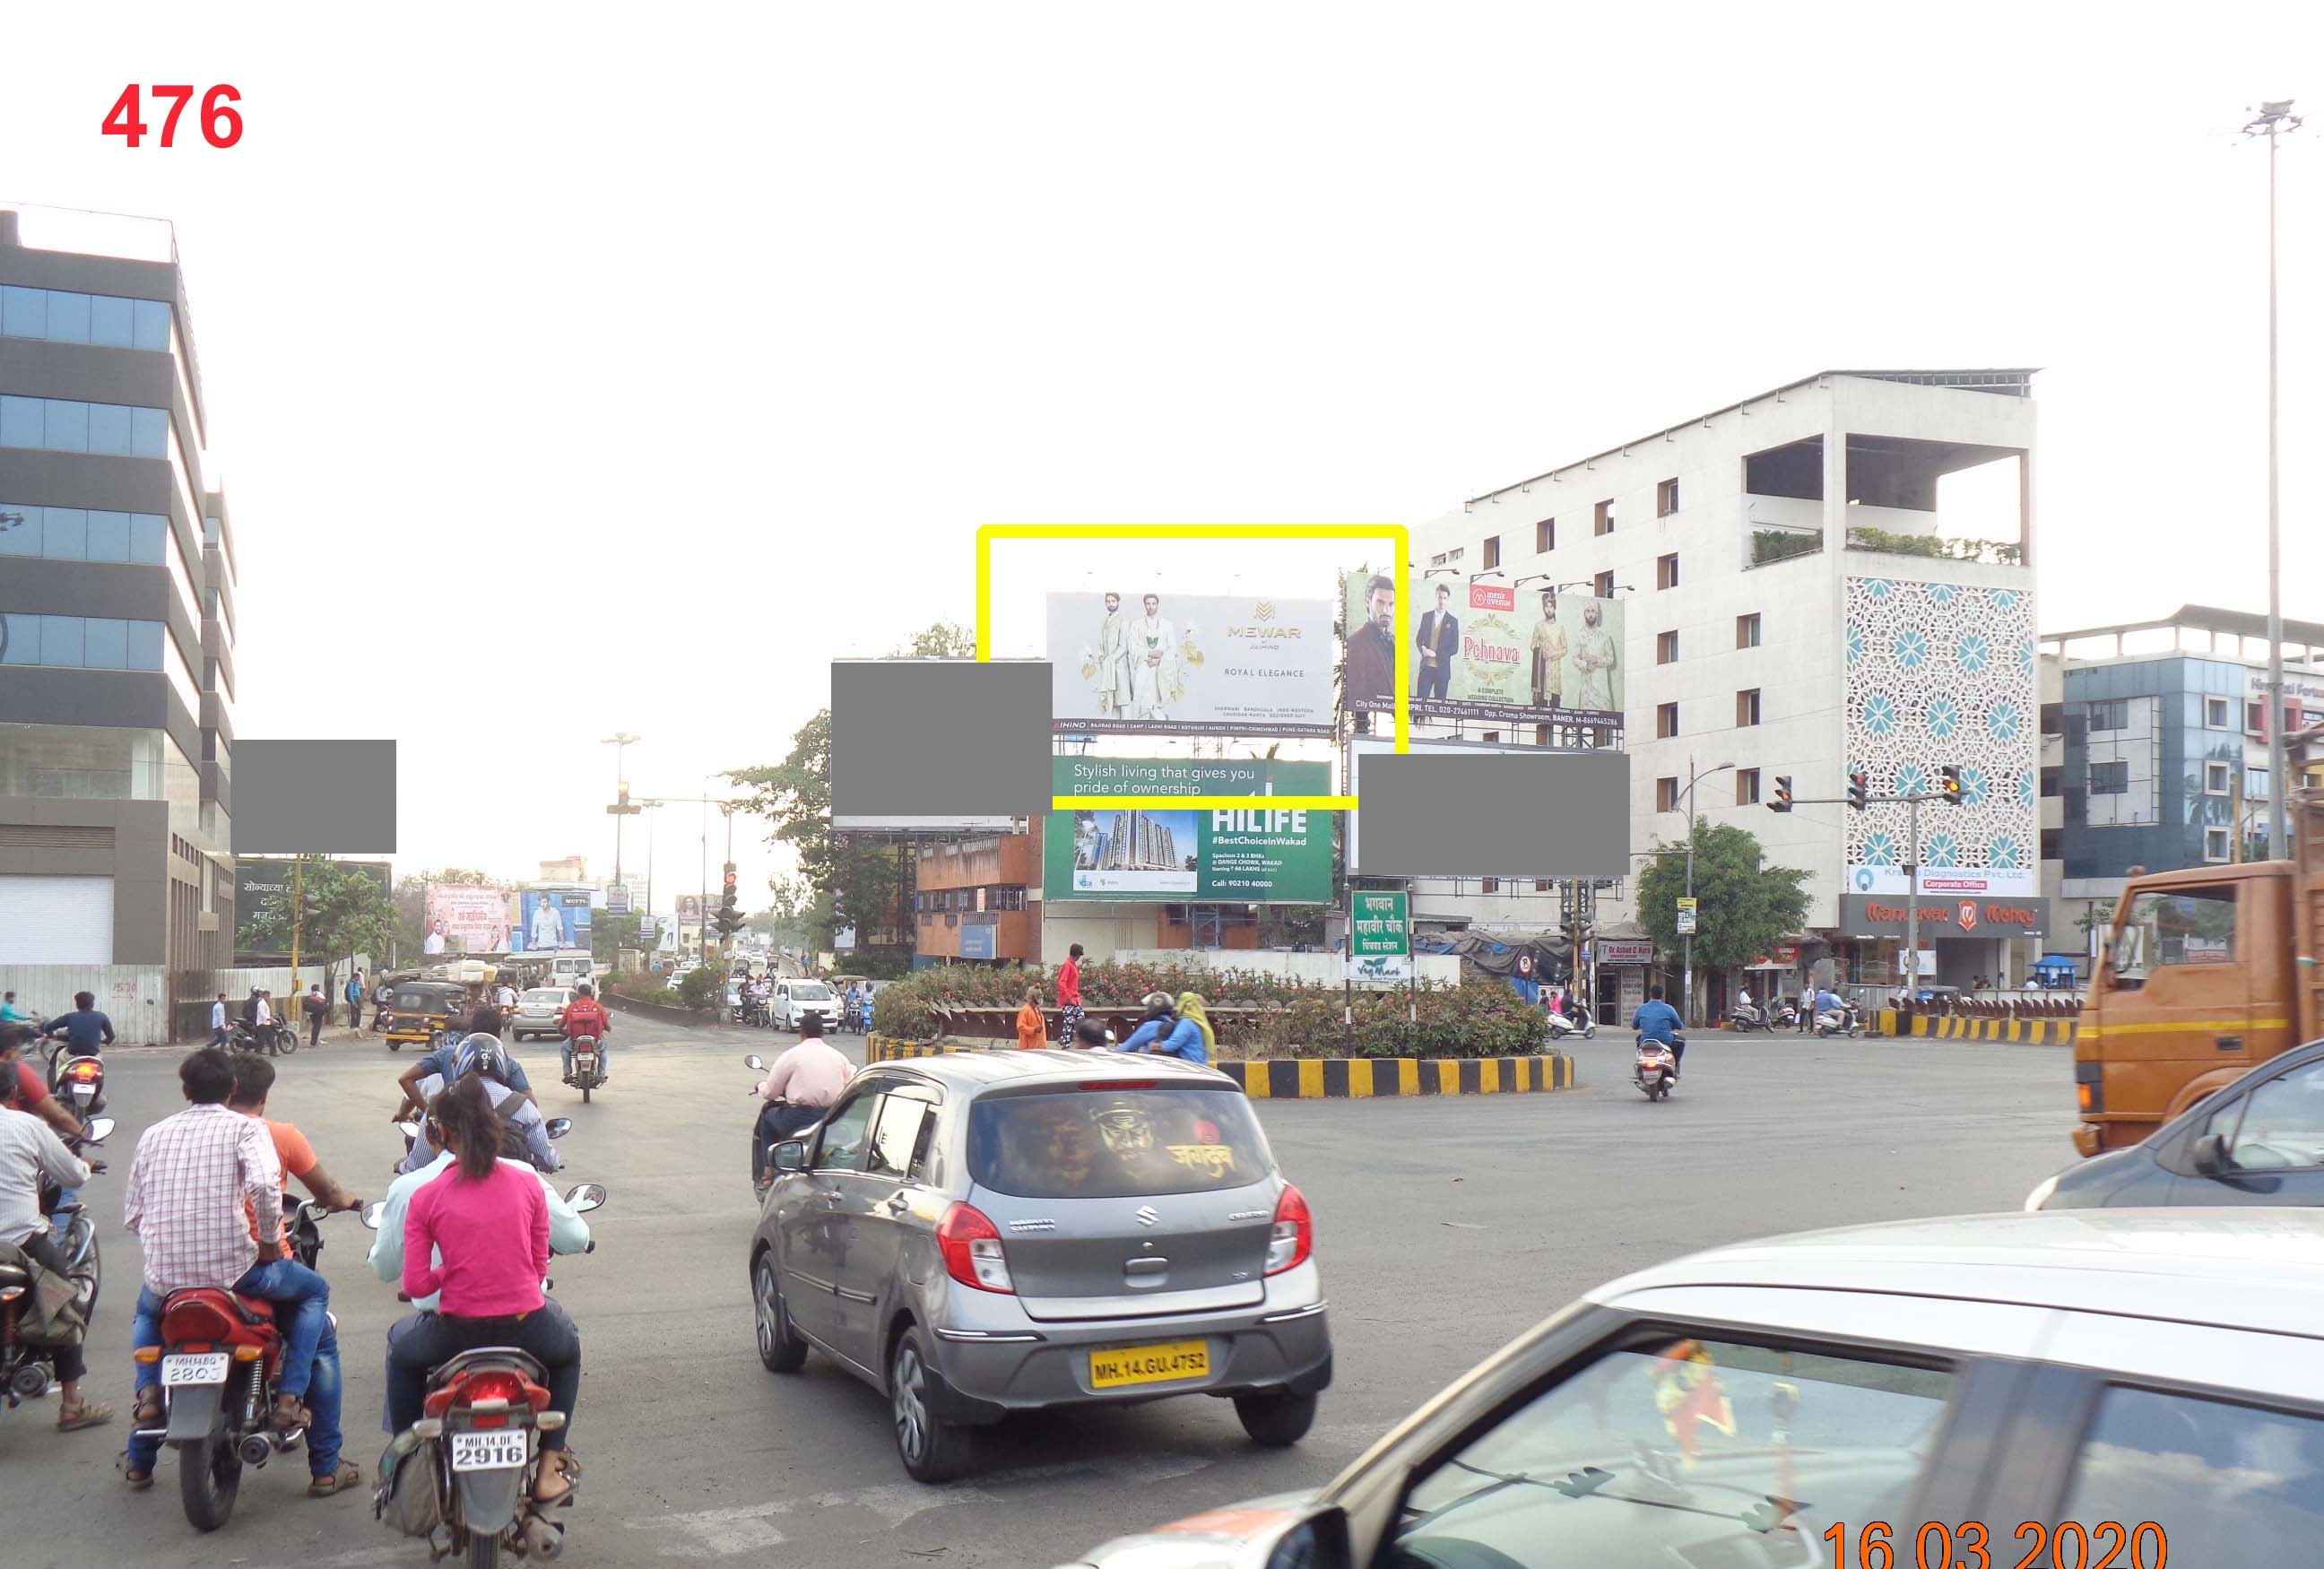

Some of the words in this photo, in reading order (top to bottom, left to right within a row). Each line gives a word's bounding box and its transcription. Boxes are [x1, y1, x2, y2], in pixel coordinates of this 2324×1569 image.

[1227, 627, 1302, 639] MEWAR
[1225, 668, 1254, 677] ROYAL
[1258, 669, 1305, 678] ELEGANCE
[1356, 699, 1367, 709] City
[1484, 709, 1498, 719] Opp.
[1074, 764, 1116, 780] Stylish
[1122, 765, 1157, 781] living
[1161, 766, 1187, 778] that
[1192, 767, 1227, 781] gives
[1230, 769, 1255, 782] you
[1074, 781, 1109, 796] pride
[1114, 781, 1129, 793] of
[1132, 782, 1201, 796] ownership
[1212, 836, 1306, 845] #BestChoiceInWakad
[1924, 869, 1981, 879] Diagnostics
[1925, 880, 1962, 889] Corporate
[1963, 880, 1986, 889] Office
[1365, 897, 1393, 912] भगवान
[1356, 915, 1384, 935] महावीर
[1384, 914, 1403, 933] चौक
[1357, 964, 1374, 977] Veg
[1374, 965, 1400, 976] Mart
[455, 1447, 523, 1466] 2916
